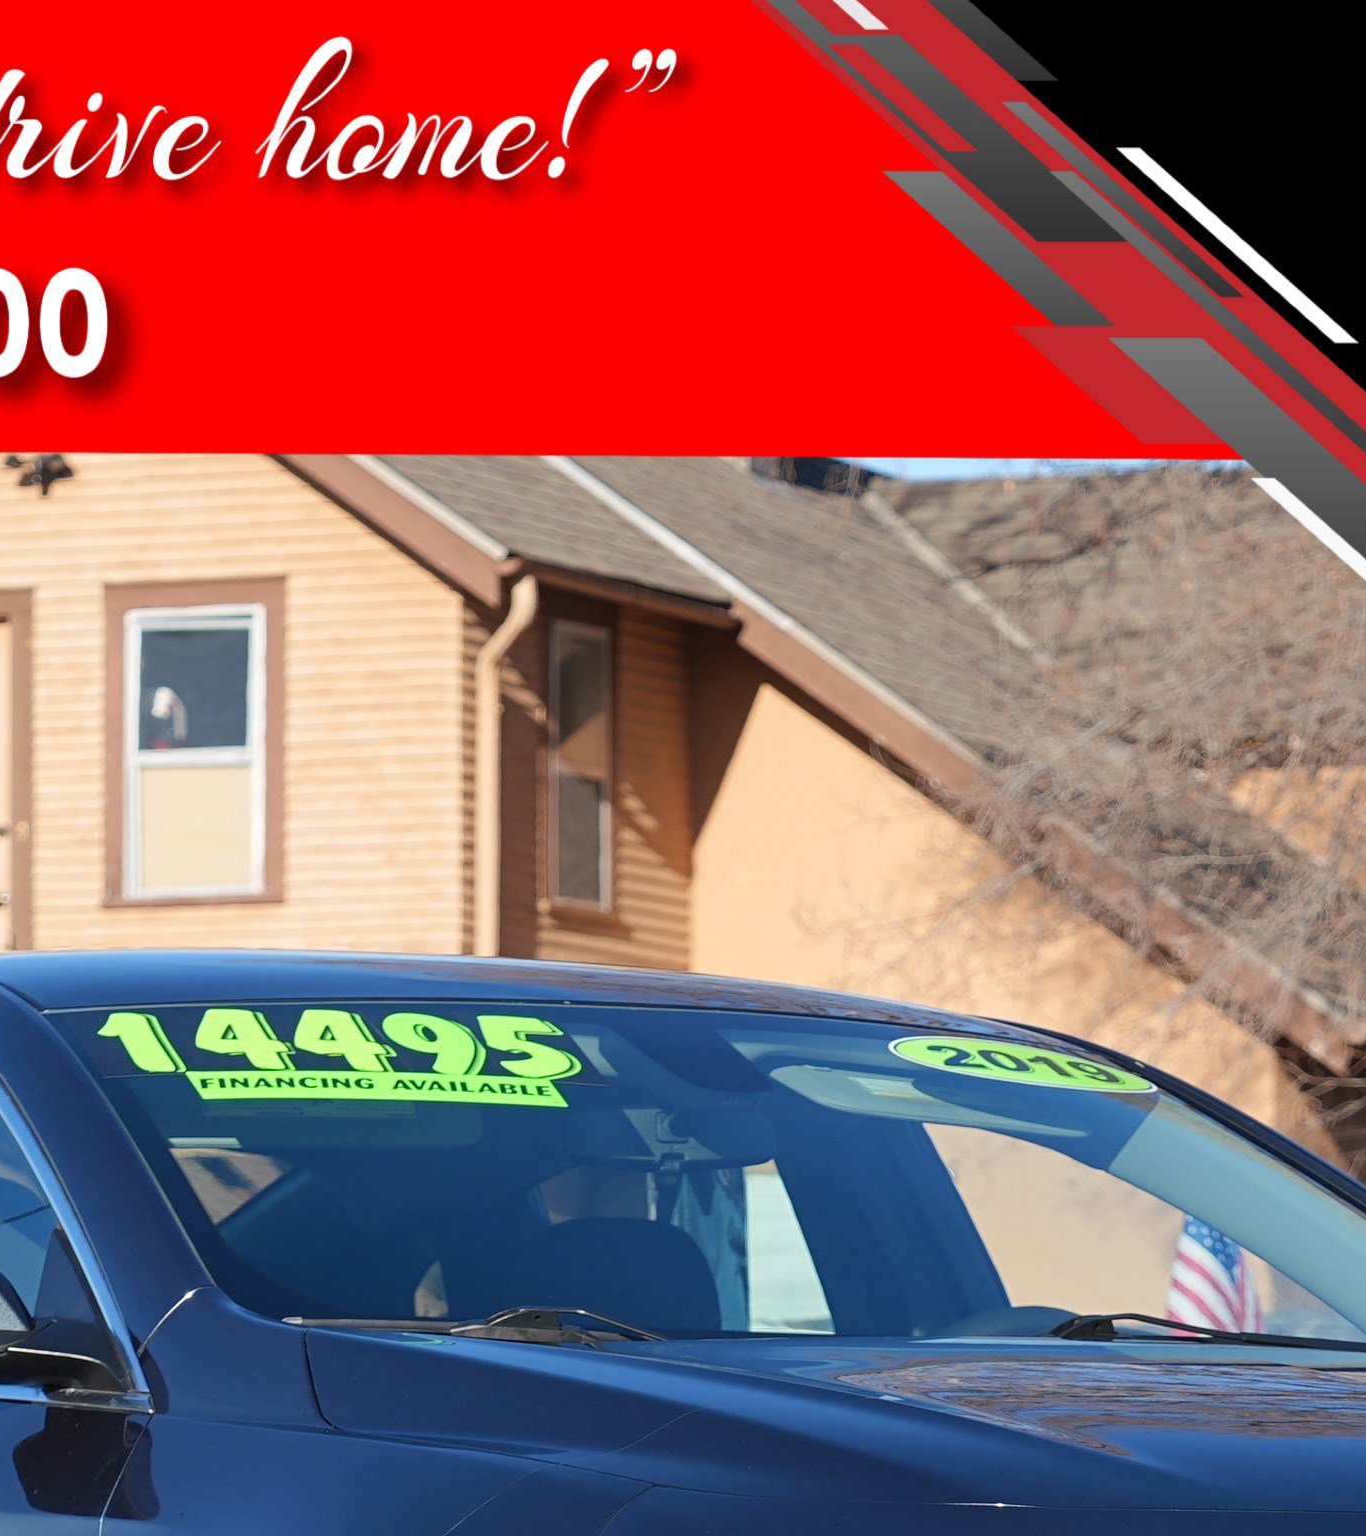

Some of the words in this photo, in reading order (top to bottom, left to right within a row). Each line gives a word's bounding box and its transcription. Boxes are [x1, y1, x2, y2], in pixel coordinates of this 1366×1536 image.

[97, 1008, 583, 1078] 14495
[926, 1044, 1125, 1084] 2019
[199, 1077, 375, 1091] FINANCING
[392, 1079, 552, 1097] AVAILABLE
